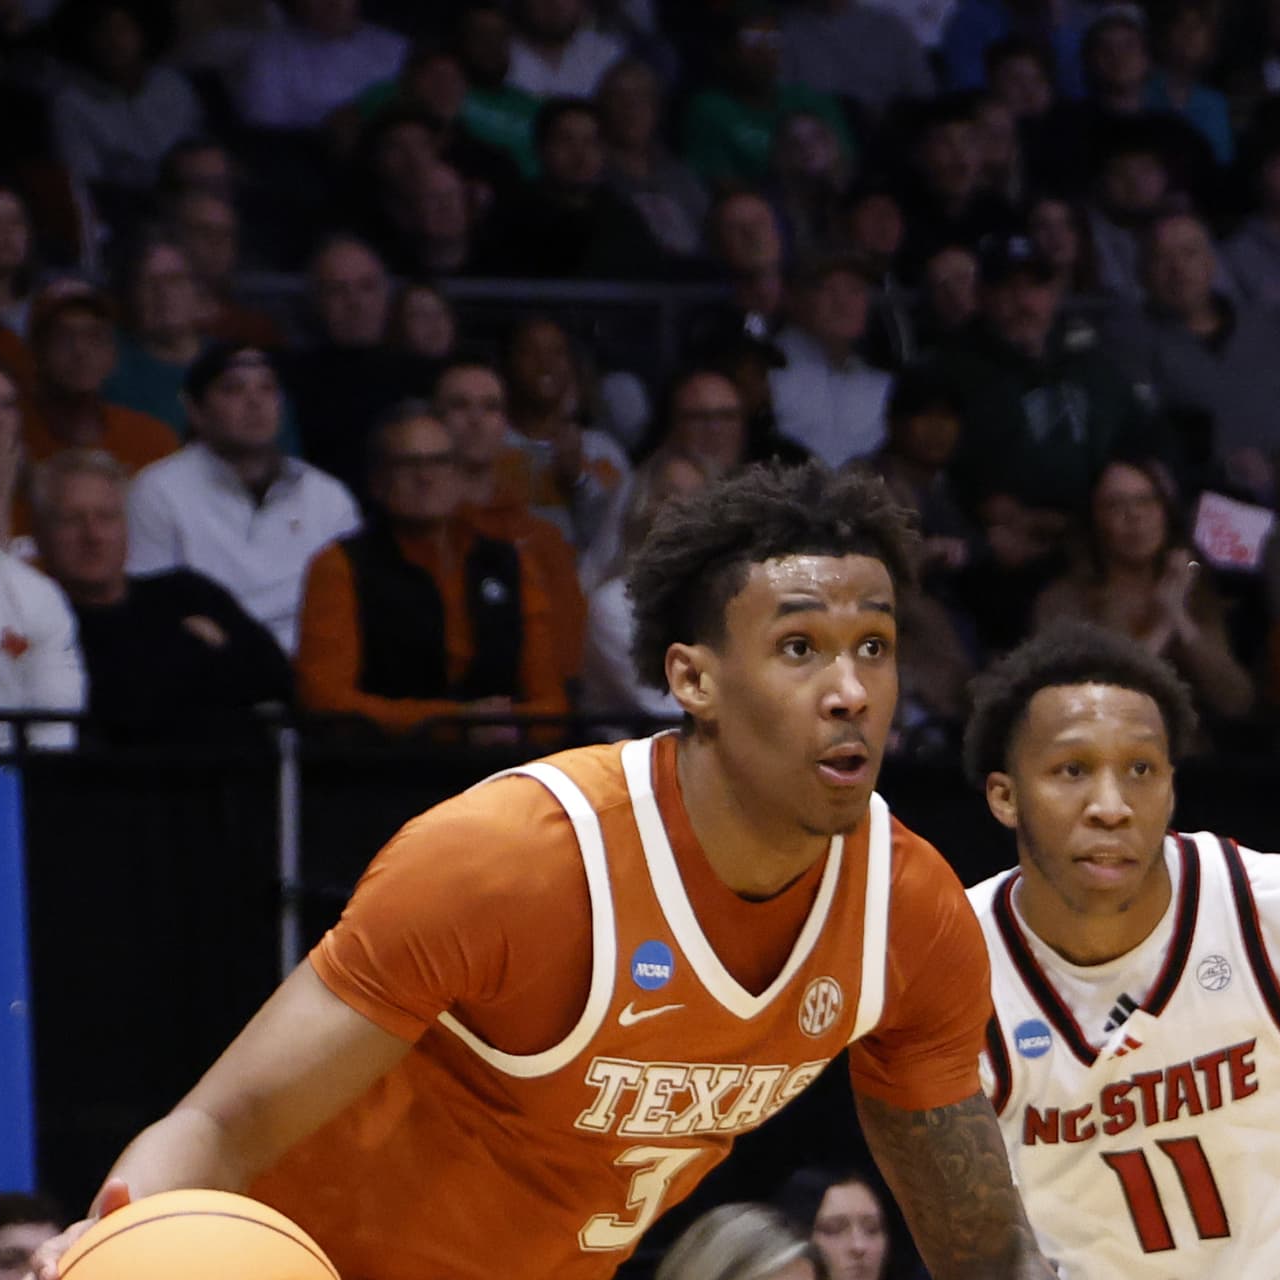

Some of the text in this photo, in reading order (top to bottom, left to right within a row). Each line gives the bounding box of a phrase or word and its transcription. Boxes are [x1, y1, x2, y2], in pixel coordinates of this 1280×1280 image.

[1022, 1037, 1260, 1146] NC STATE
[578, 1145, 703, 1251] 3
[1099, 1135, 1231, 1254] 11
